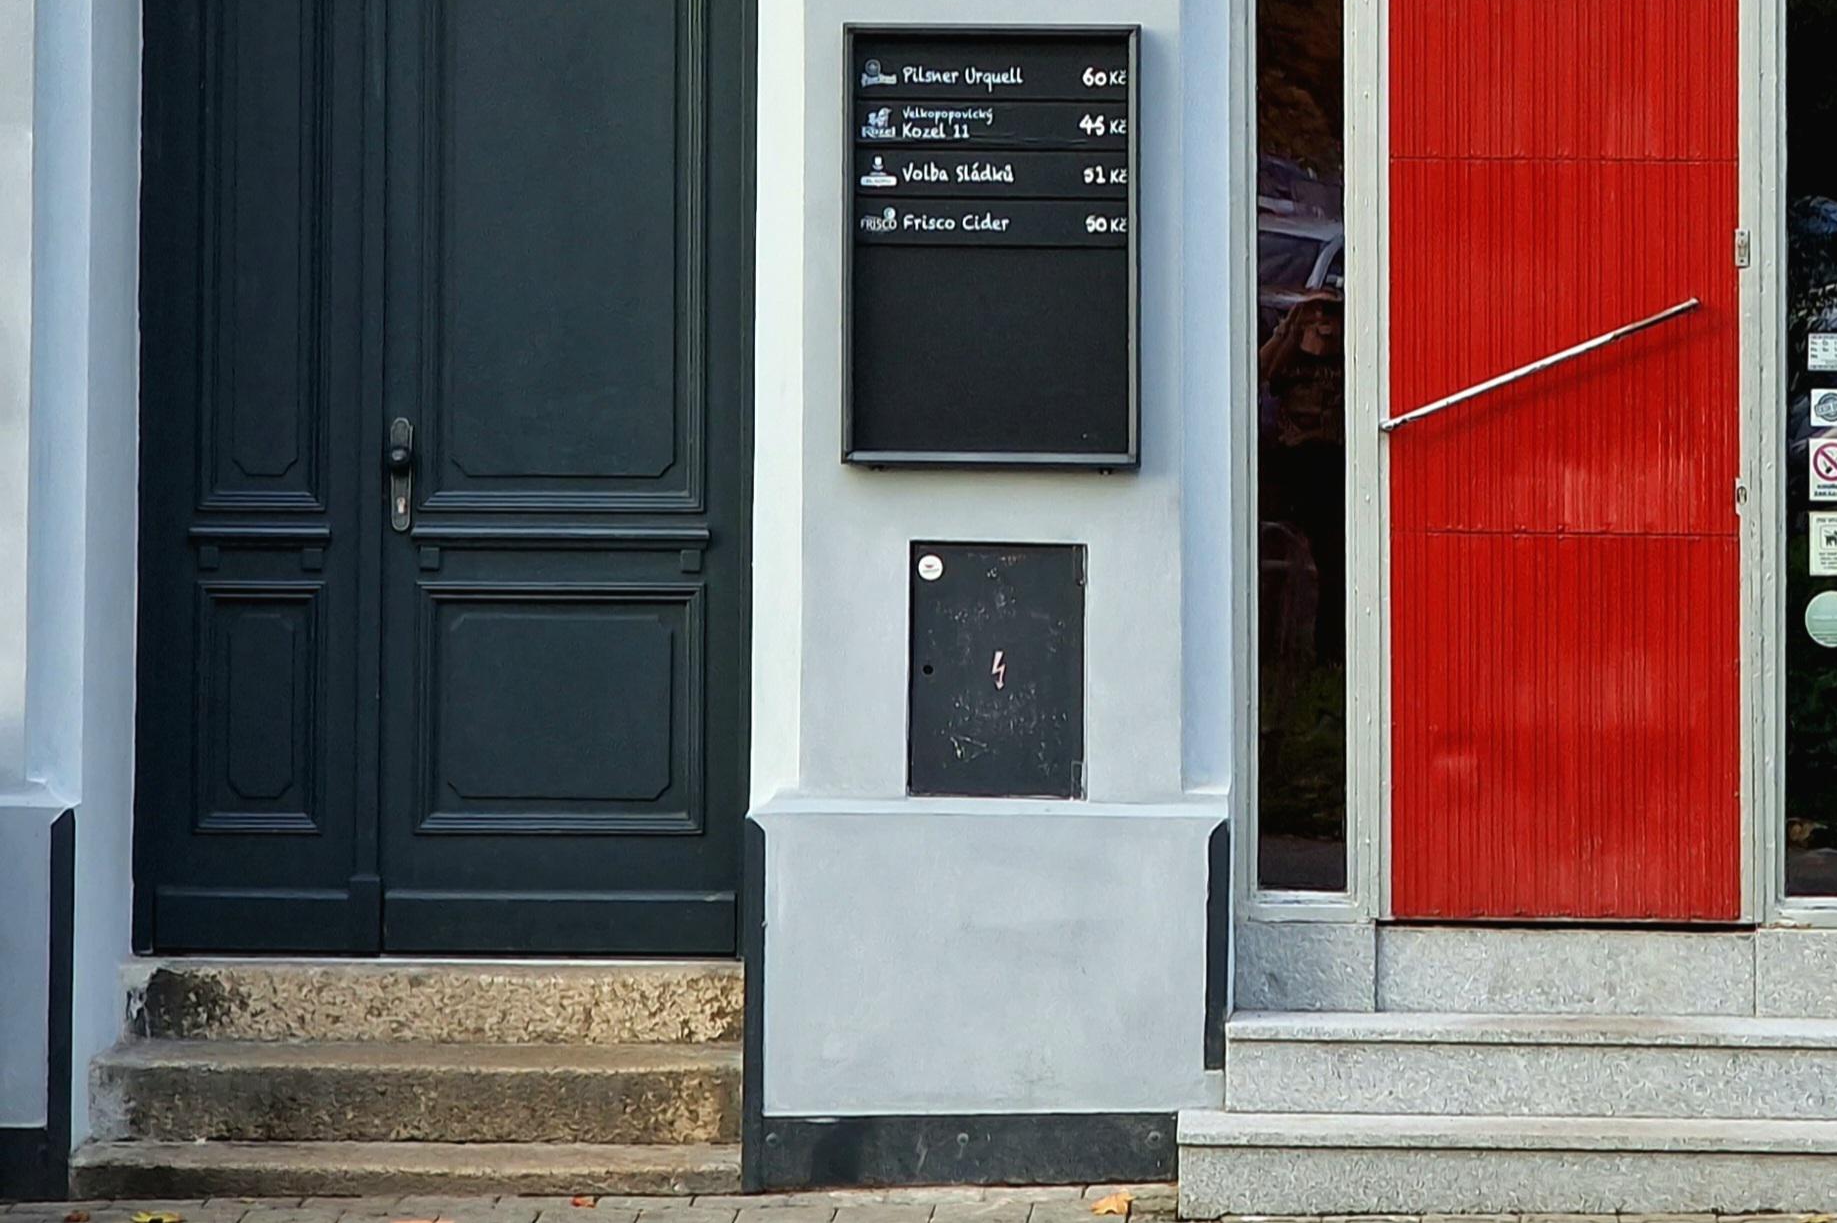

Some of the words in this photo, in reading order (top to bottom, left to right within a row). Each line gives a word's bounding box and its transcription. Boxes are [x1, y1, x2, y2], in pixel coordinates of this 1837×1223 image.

[902, 66, 959, 84] Pilsner
[964, 67, 1023, 93] Urquell
[1082, 67, 1107, 87] 60
[1109, 70, 1126, 85] Kč
[902, 105, 994, 126] Velkopopovický
[902, 121, 946, 139] Kozel
[953, 123, 970, 139] 11
[1109, 119, 1127, 134] Kč
[902, 161, 949, 182] Volba
[955, 162, 1014, 183] Sládků
[1109, 168, 1127, 184] Kč
[903, 214, 956, 231] Frisco
[962, 212, 1010, 231] Cider
[1110, 217, 1127, 233] Kč
